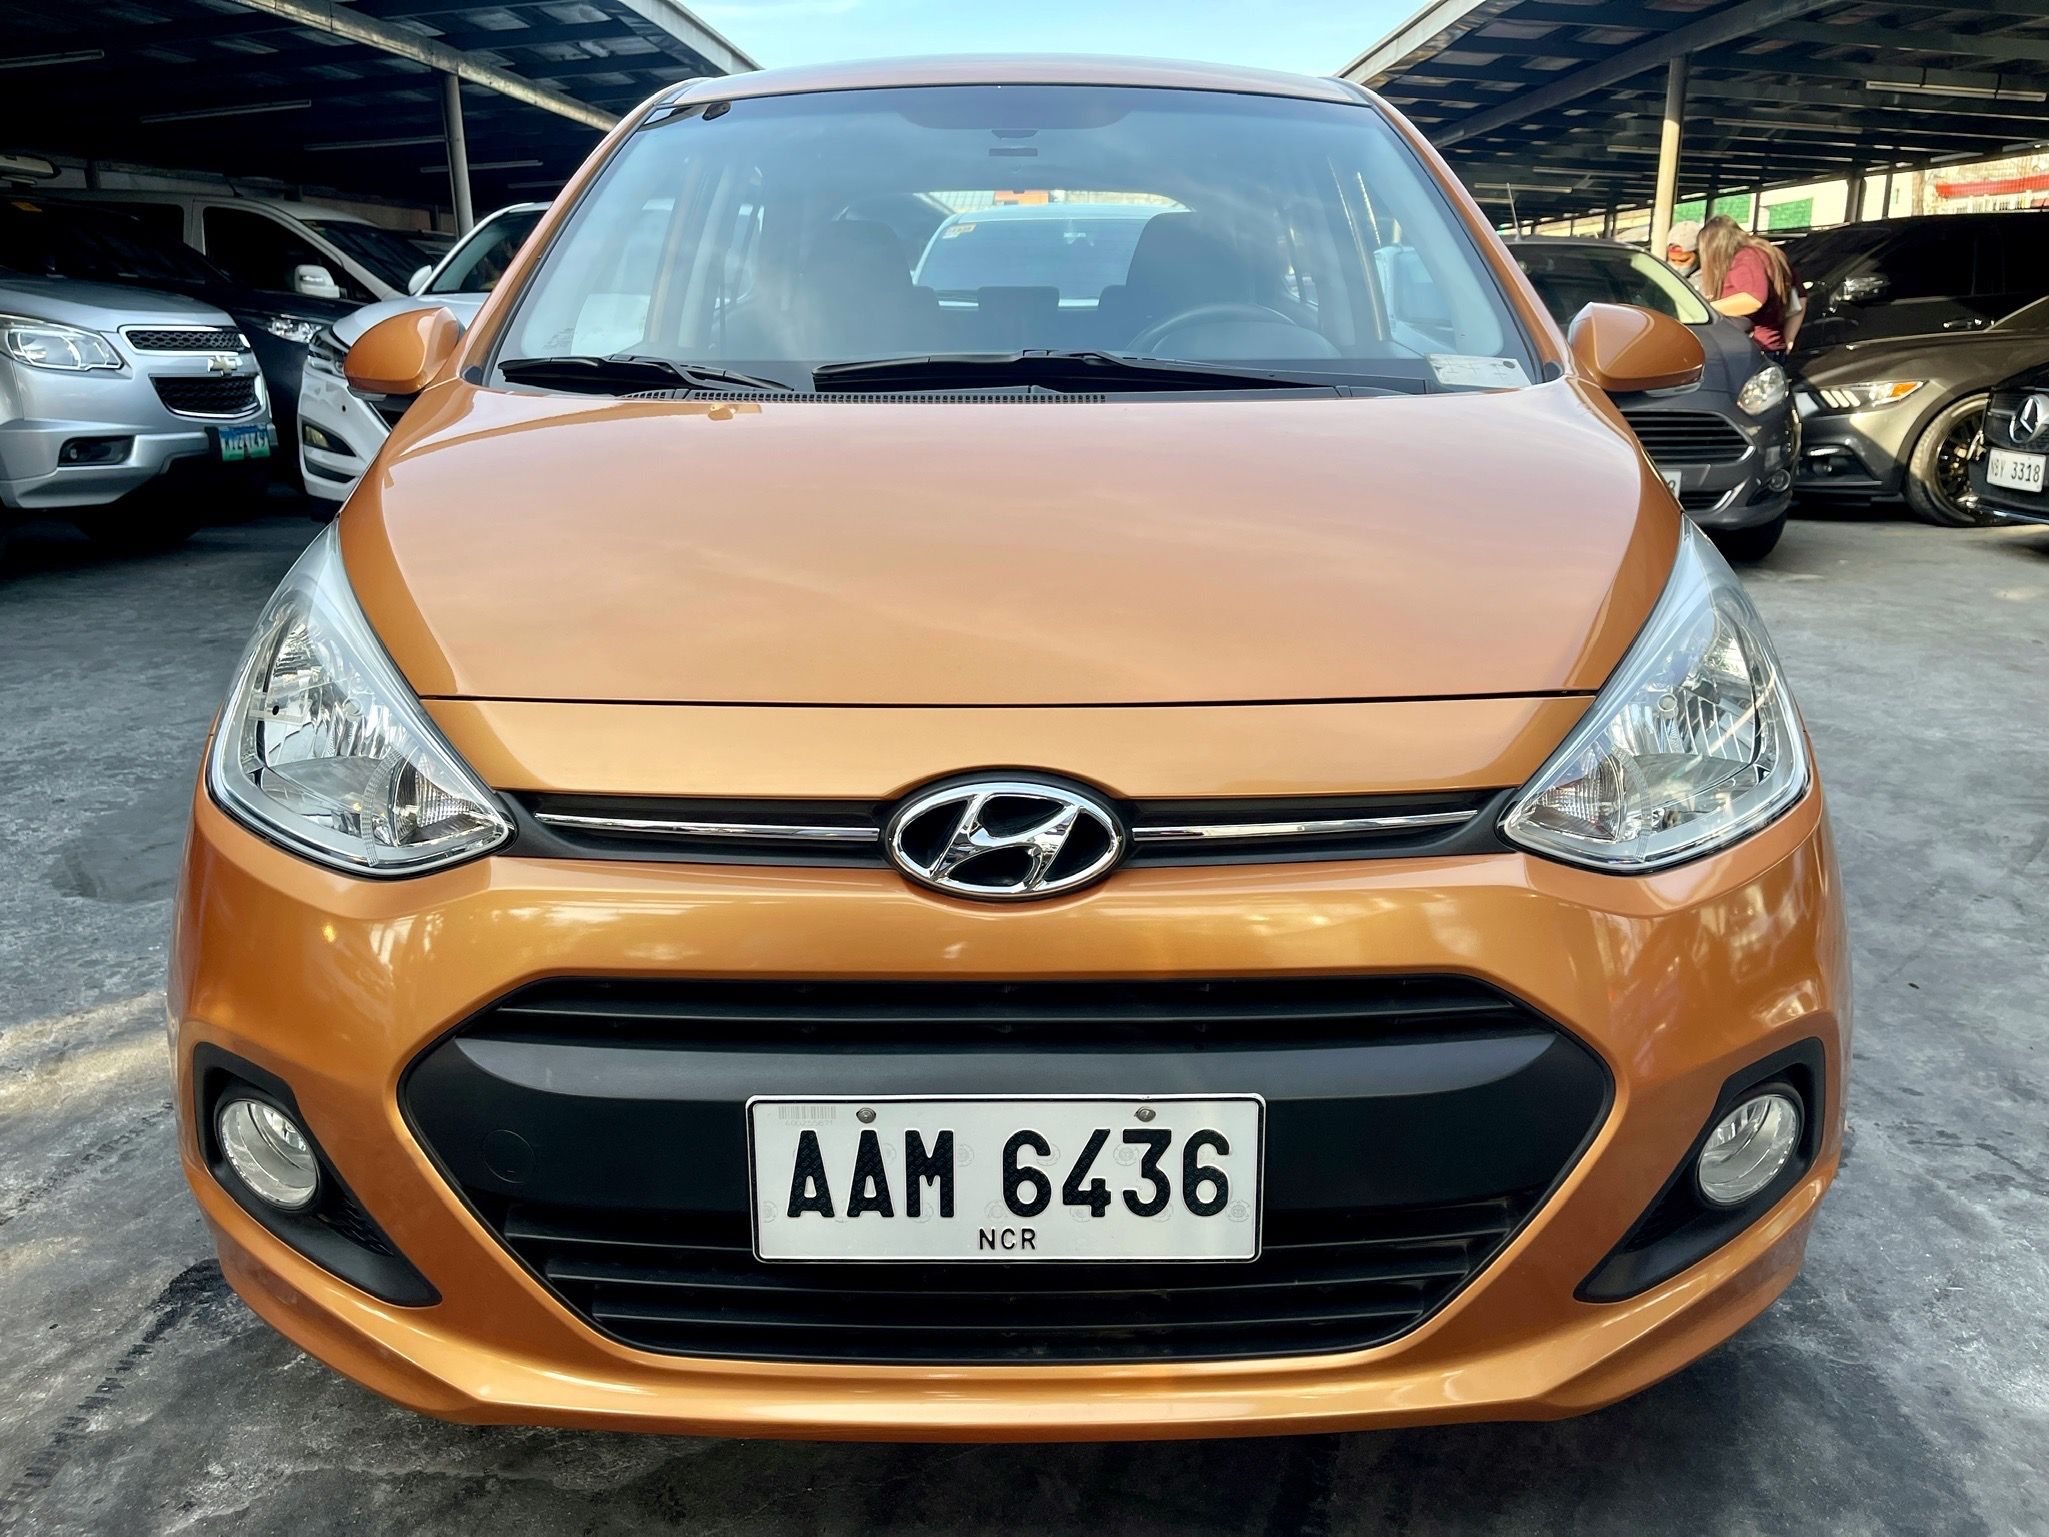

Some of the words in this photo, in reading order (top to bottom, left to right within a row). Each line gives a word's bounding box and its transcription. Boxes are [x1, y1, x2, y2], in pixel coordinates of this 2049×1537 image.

[2011, 461, 2041, 482] 3318
[787, 1130, 954, 1217] AAM
[1003, 1129, 1229, 1217] 6436
[980, 1229, 1036, 1250] NCR
